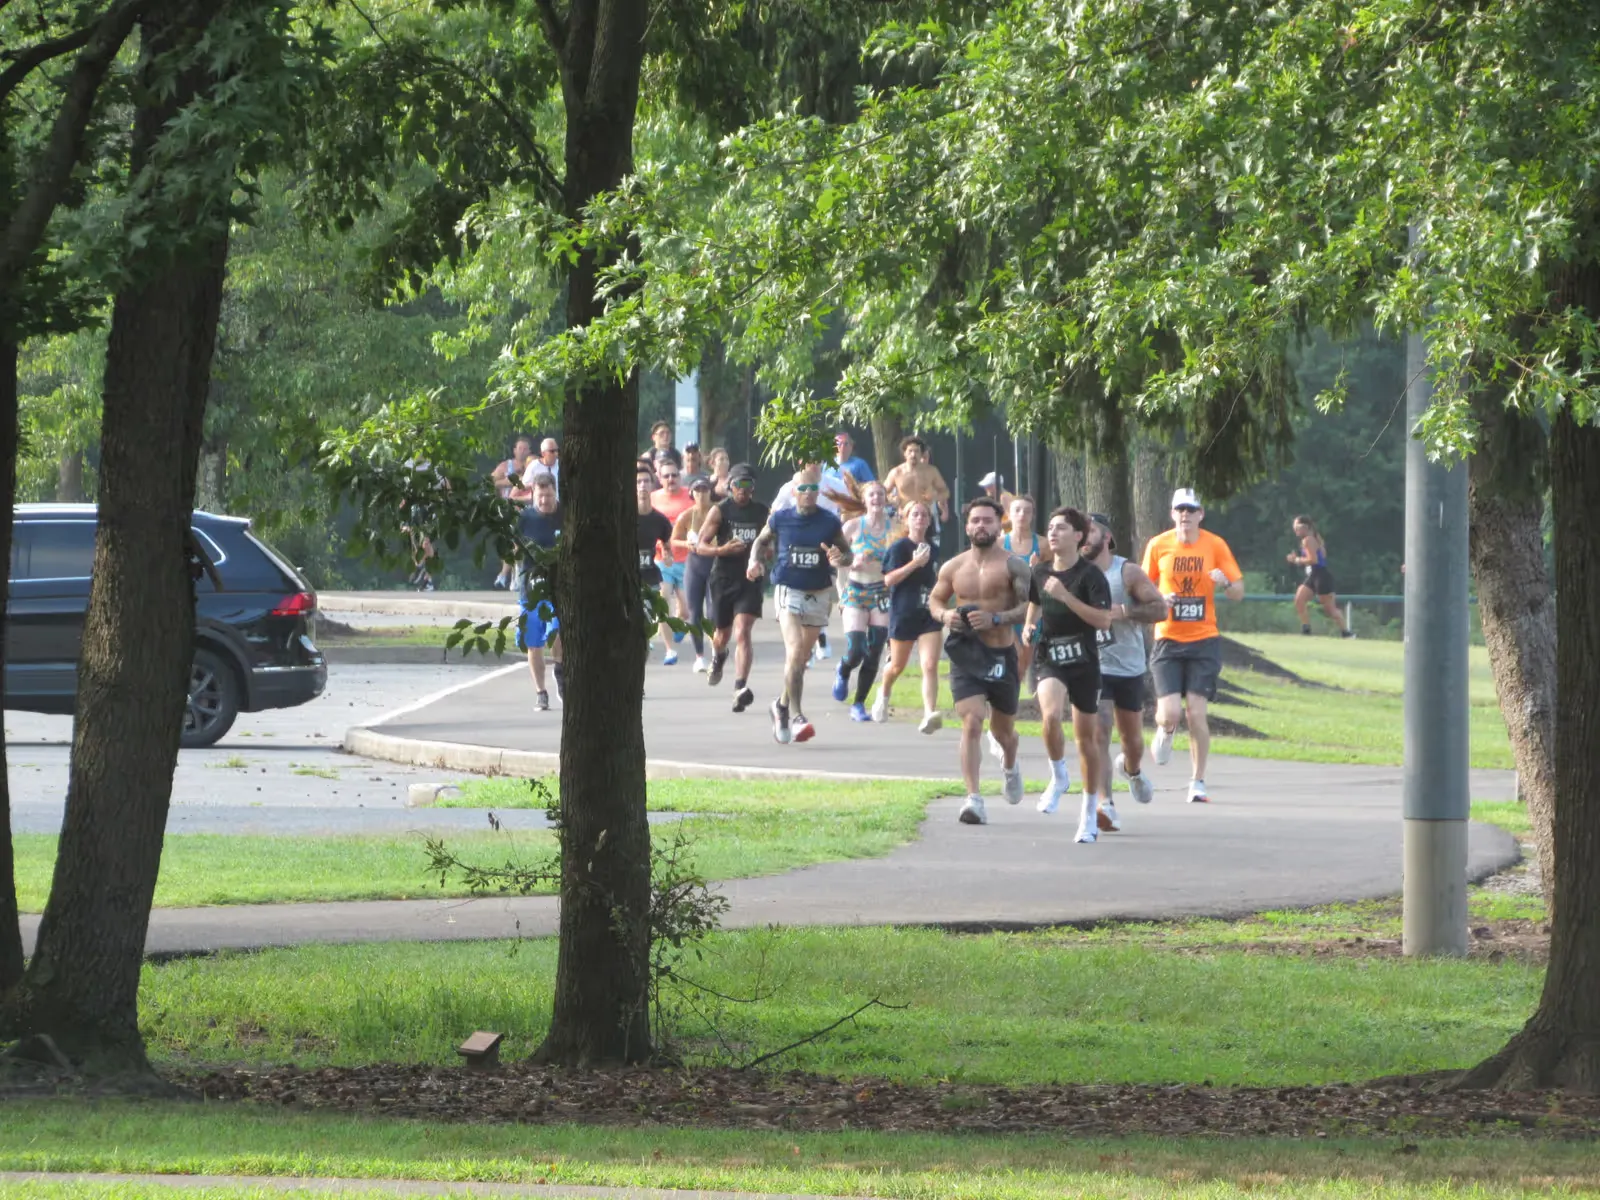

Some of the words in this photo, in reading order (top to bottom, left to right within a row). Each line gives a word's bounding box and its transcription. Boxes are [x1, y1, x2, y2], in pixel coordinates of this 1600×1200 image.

[791, 552, 819, 565] 1129
[1173, 556, 1204, 572] RRCW
[1174, 604, 1203, 617] 1291
[1049, 642, 1082, 661] 1311
